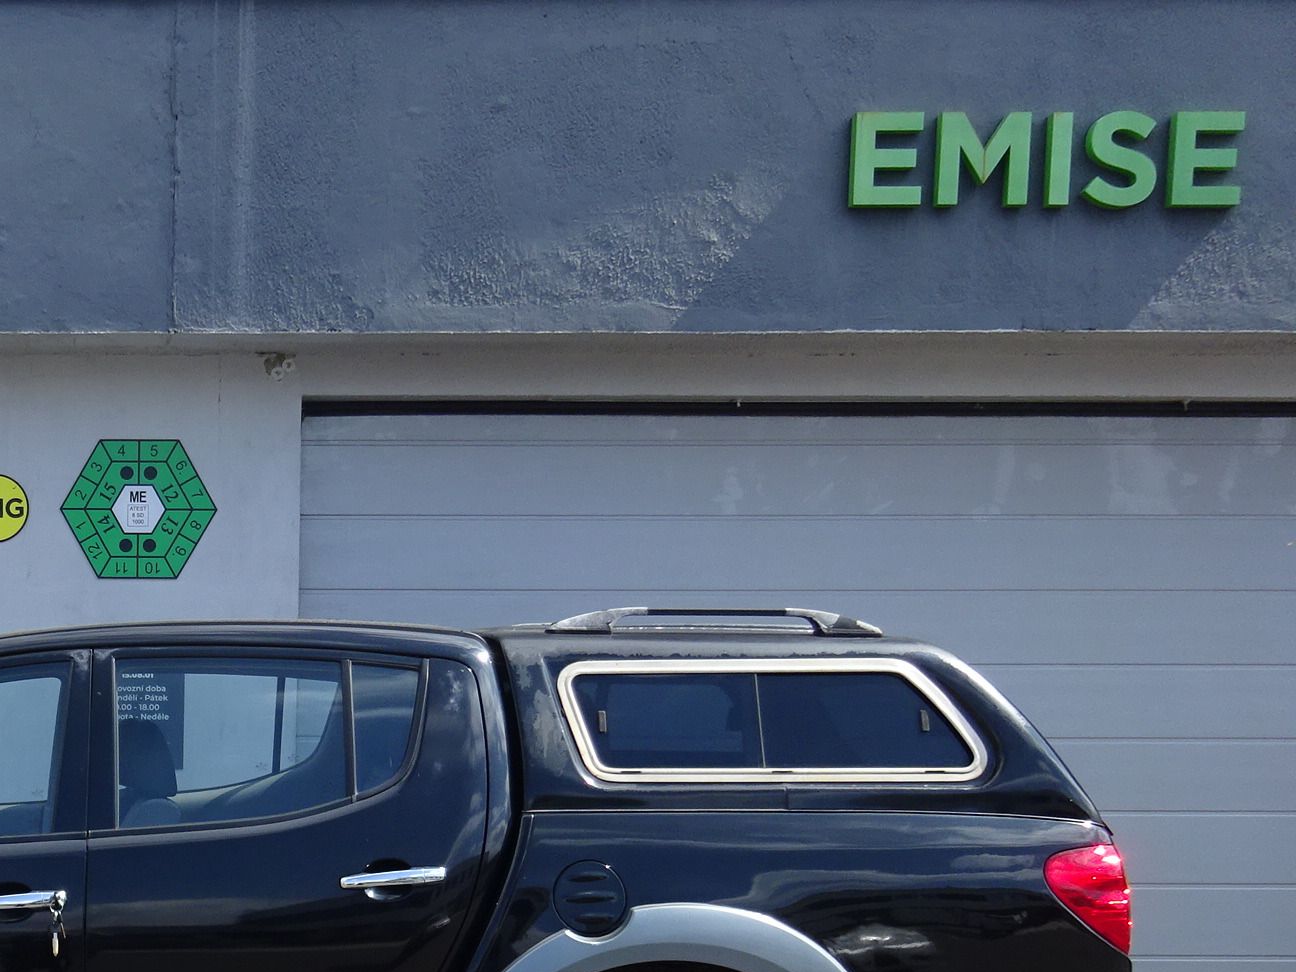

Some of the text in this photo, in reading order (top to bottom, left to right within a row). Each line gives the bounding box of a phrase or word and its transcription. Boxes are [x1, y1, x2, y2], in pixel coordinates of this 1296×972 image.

[848, 110, 1247, 209] EMISE
[117, 444, 126, 456] 4
[150, 444, 159, 457] 5
[90, 462, 103, 473] 3
[75, 489, 87, 501] 2
[99, 482, 117, 501] 15
[129, 491, 147, 503] ME
[161, 483, 179, 503] 12
[191, 488, 204, 498] 7
[76, 521, 86, 530] 1
[97, 514, 116, 534] 14
[160, 516, 179, 535] 13
[190, 520, 202, 531] 8
[87, 542, 103, 560] 12
[115, 562, 128, 574] 11
[145, 562, 161, 575] 10
[144, 694, 169, 702] Pátek
